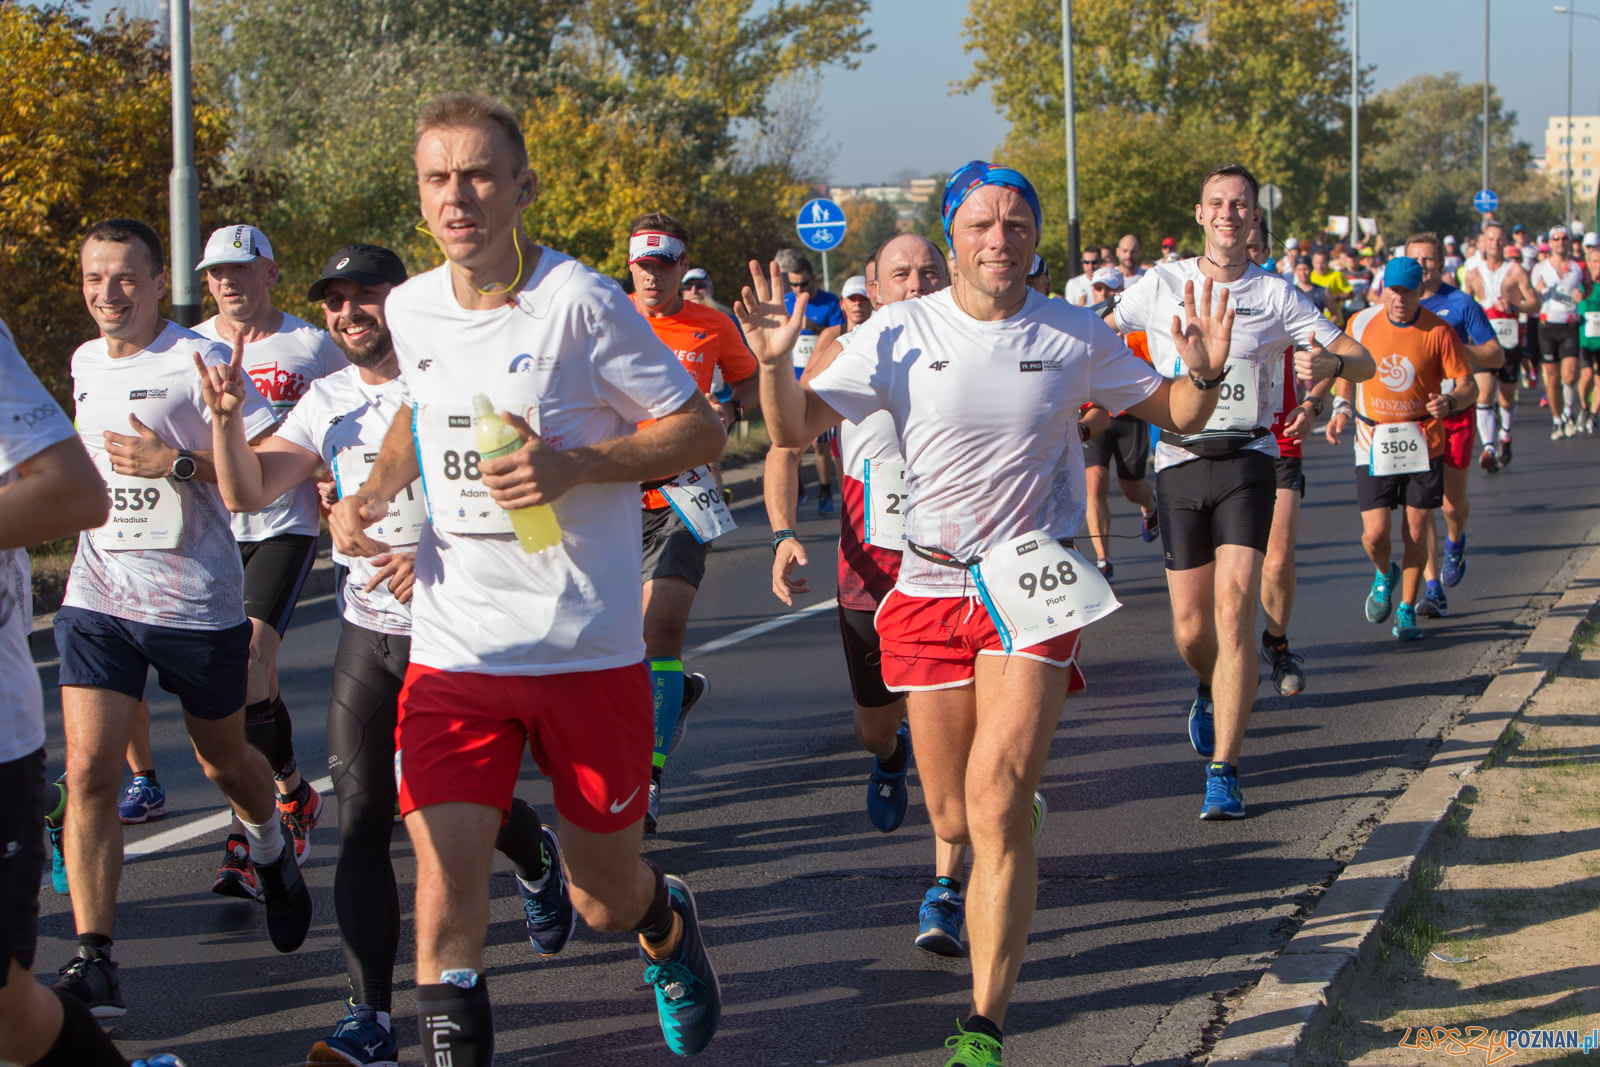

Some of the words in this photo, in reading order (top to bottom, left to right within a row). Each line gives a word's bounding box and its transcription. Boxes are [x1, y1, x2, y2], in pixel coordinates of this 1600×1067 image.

[929, 360, 949, 371] 4F
[1380, 440, 1418, 454] 3506
[461, 489, 488, 497] Adam
[690, 488, 724, 511] 190
[1018, 560, 1078, 599] 968
[1045, 595, 1067, 607] Piotr
